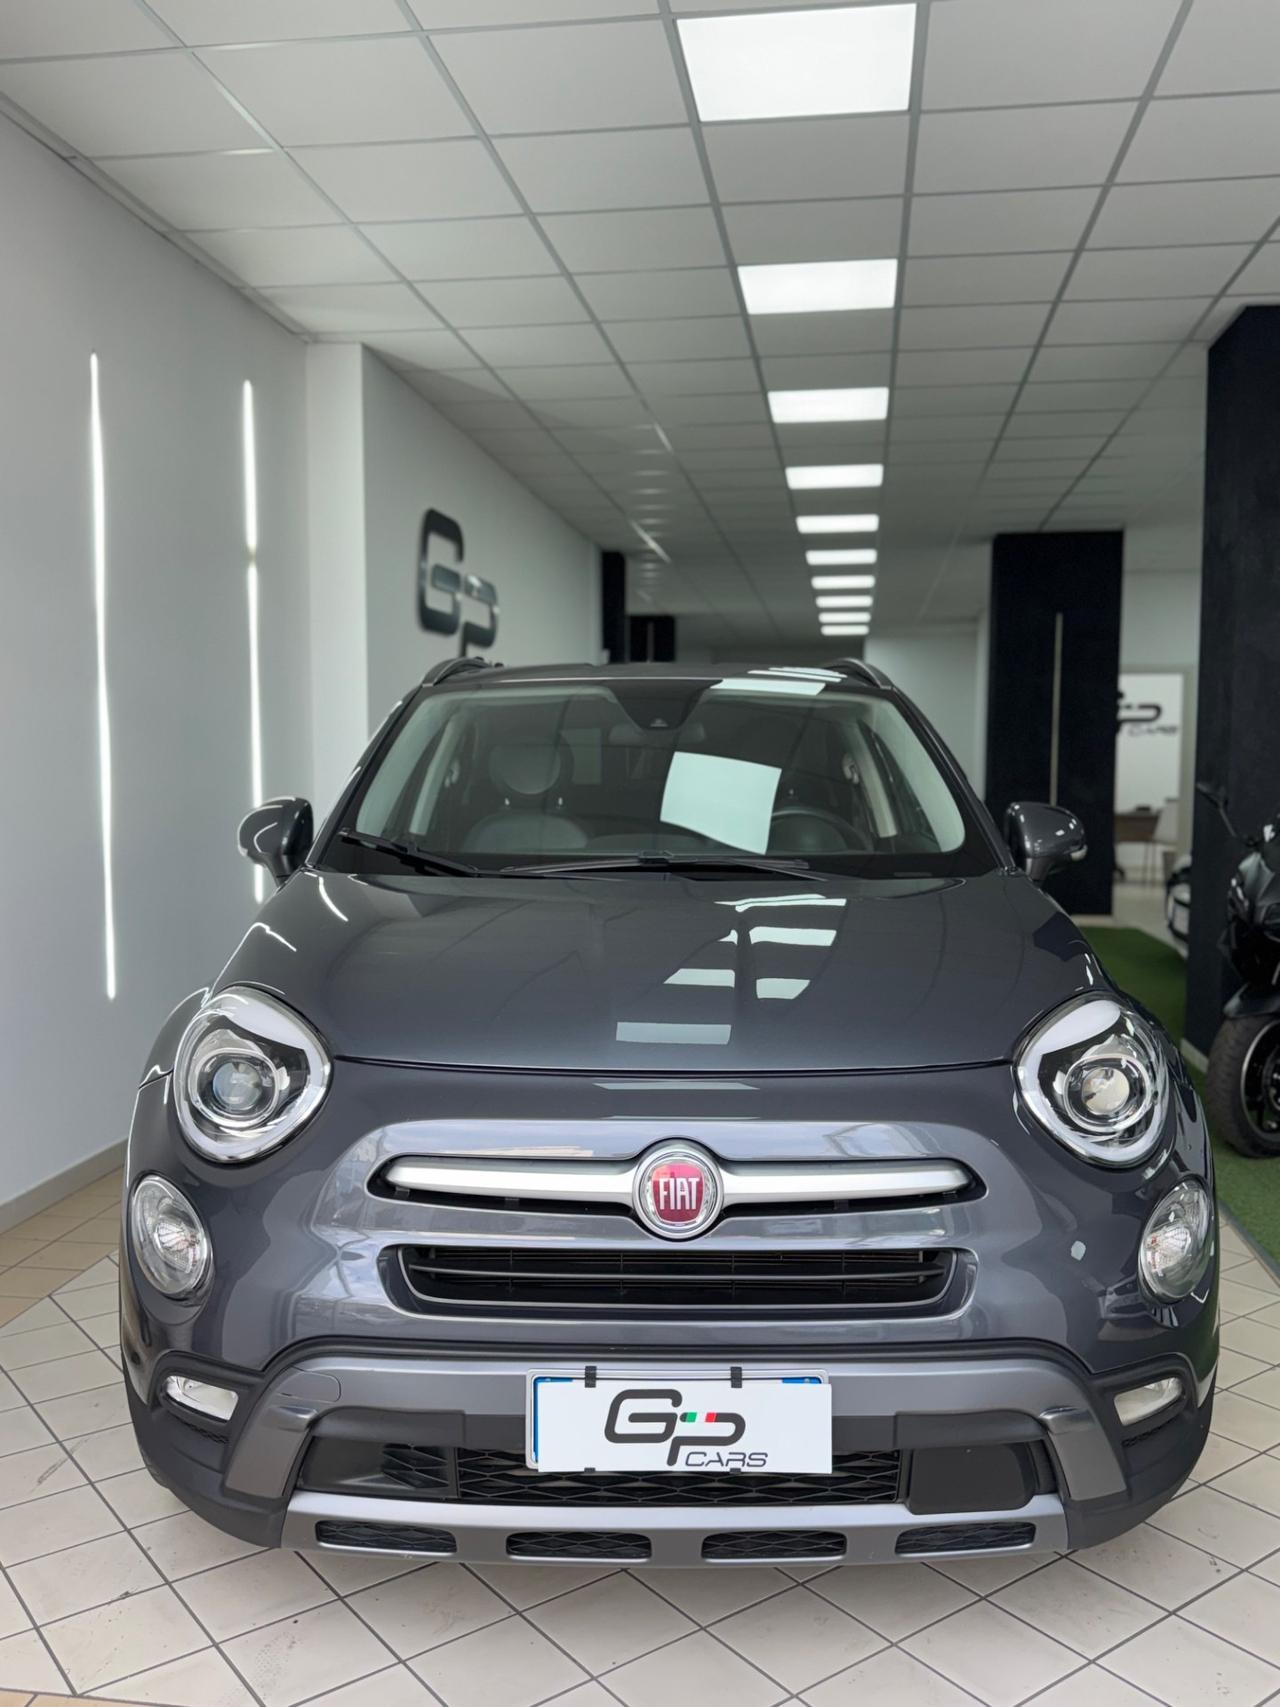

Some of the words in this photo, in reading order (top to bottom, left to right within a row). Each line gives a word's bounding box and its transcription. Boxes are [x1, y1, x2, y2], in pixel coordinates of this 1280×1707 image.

[659, 1177, 699, 1210] FIAT
[604, 1388, 746, 1466] GP
[685, 1451, 768, 1467] CARS
